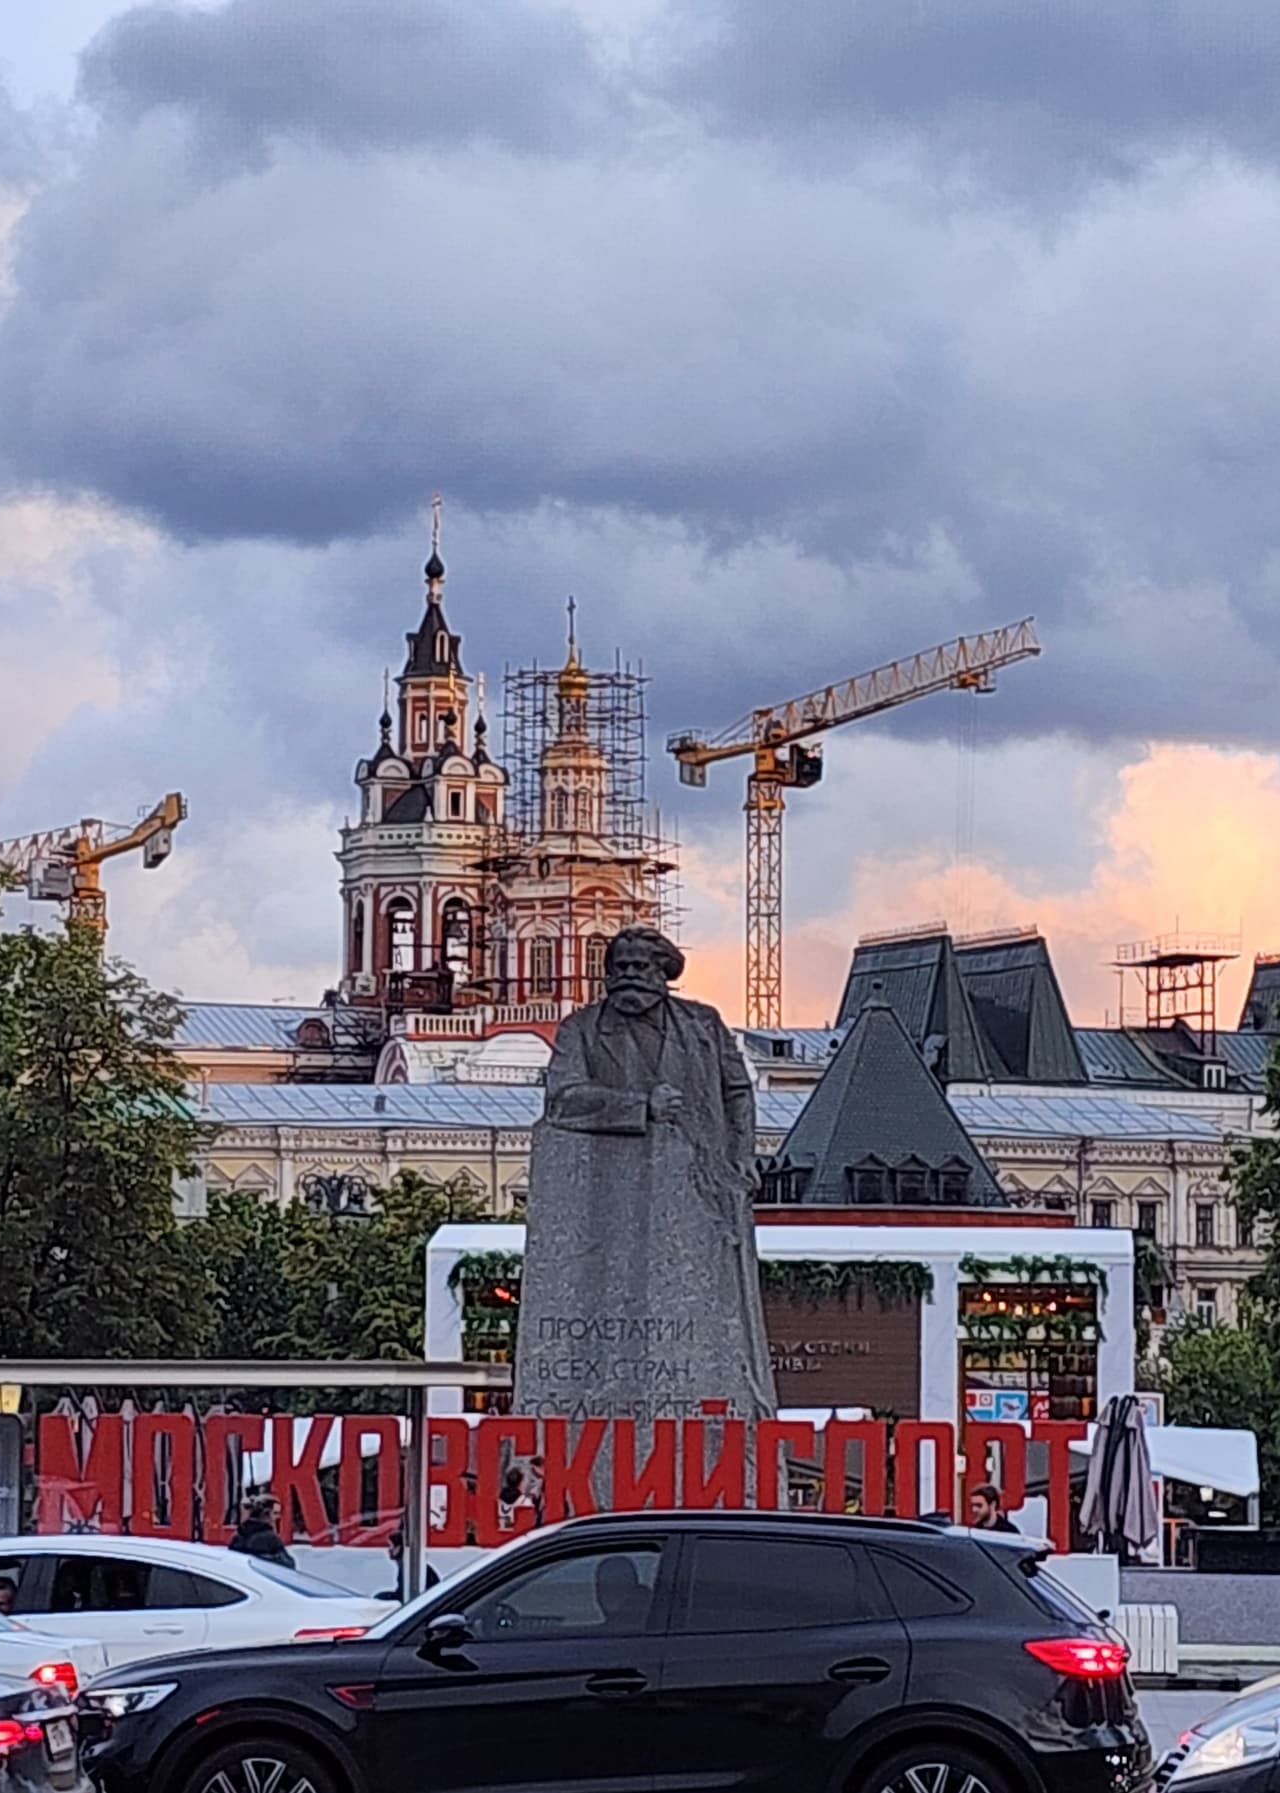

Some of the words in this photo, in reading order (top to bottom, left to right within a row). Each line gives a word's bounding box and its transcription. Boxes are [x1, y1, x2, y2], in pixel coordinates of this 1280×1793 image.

[538, 1317, 694, 1341] ПРОЛЕТАРИИ
[537, 1358, 600, 1381] ВСЕХ
[38, 1399, 746, 1549] МОСКОВСКИЙ
